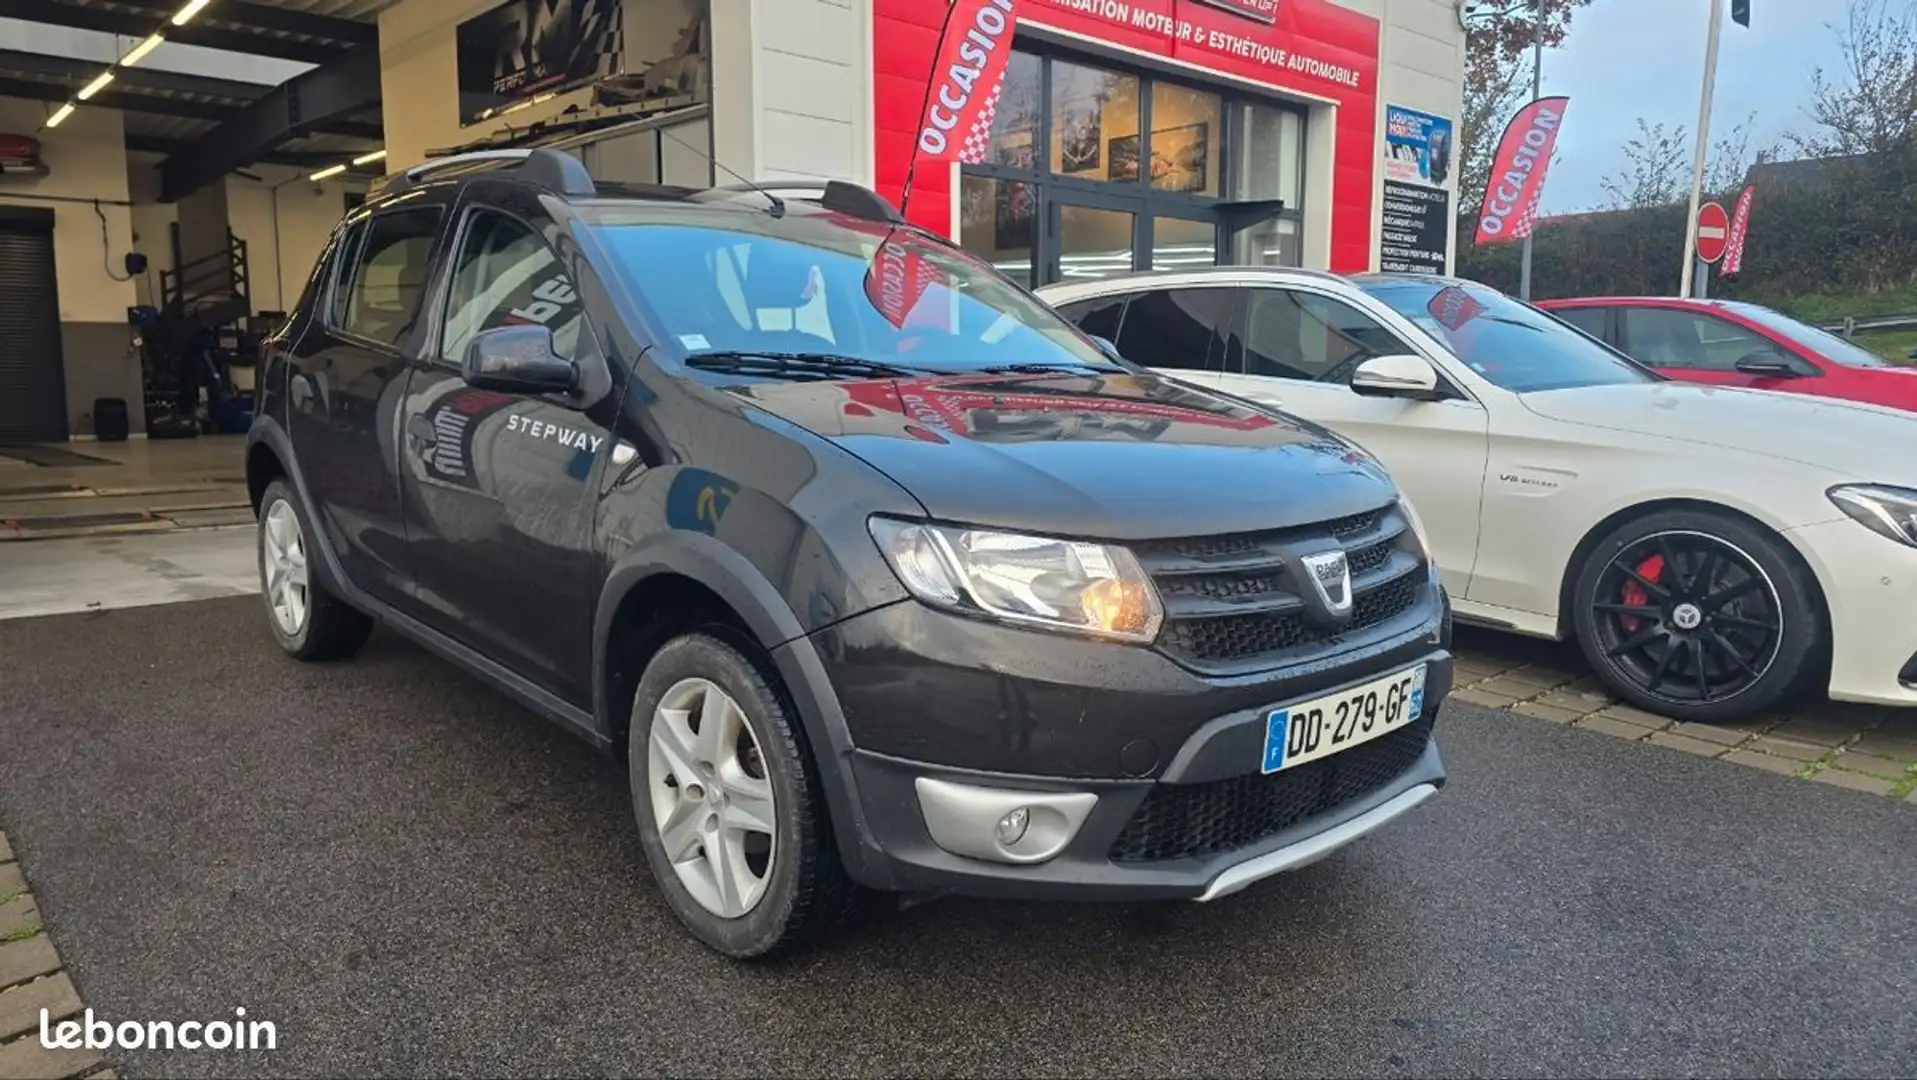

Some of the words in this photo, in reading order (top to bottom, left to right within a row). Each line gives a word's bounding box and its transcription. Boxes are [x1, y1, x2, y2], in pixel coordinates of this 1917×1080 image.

[1131, 7, 1192, 41] MOTEUR
[1193, 27, 1206, 44] &
[1208, 29, 1287, 67] ESTHÉTIQUE
[1287, 54, 1360, 88] AUTOMOBILE
[1480, 107, 1561, 235] OCCASION
[506, 413, 604, 454] STEPWAY
[1286, 677, 1412, 760] DD-279-GF
